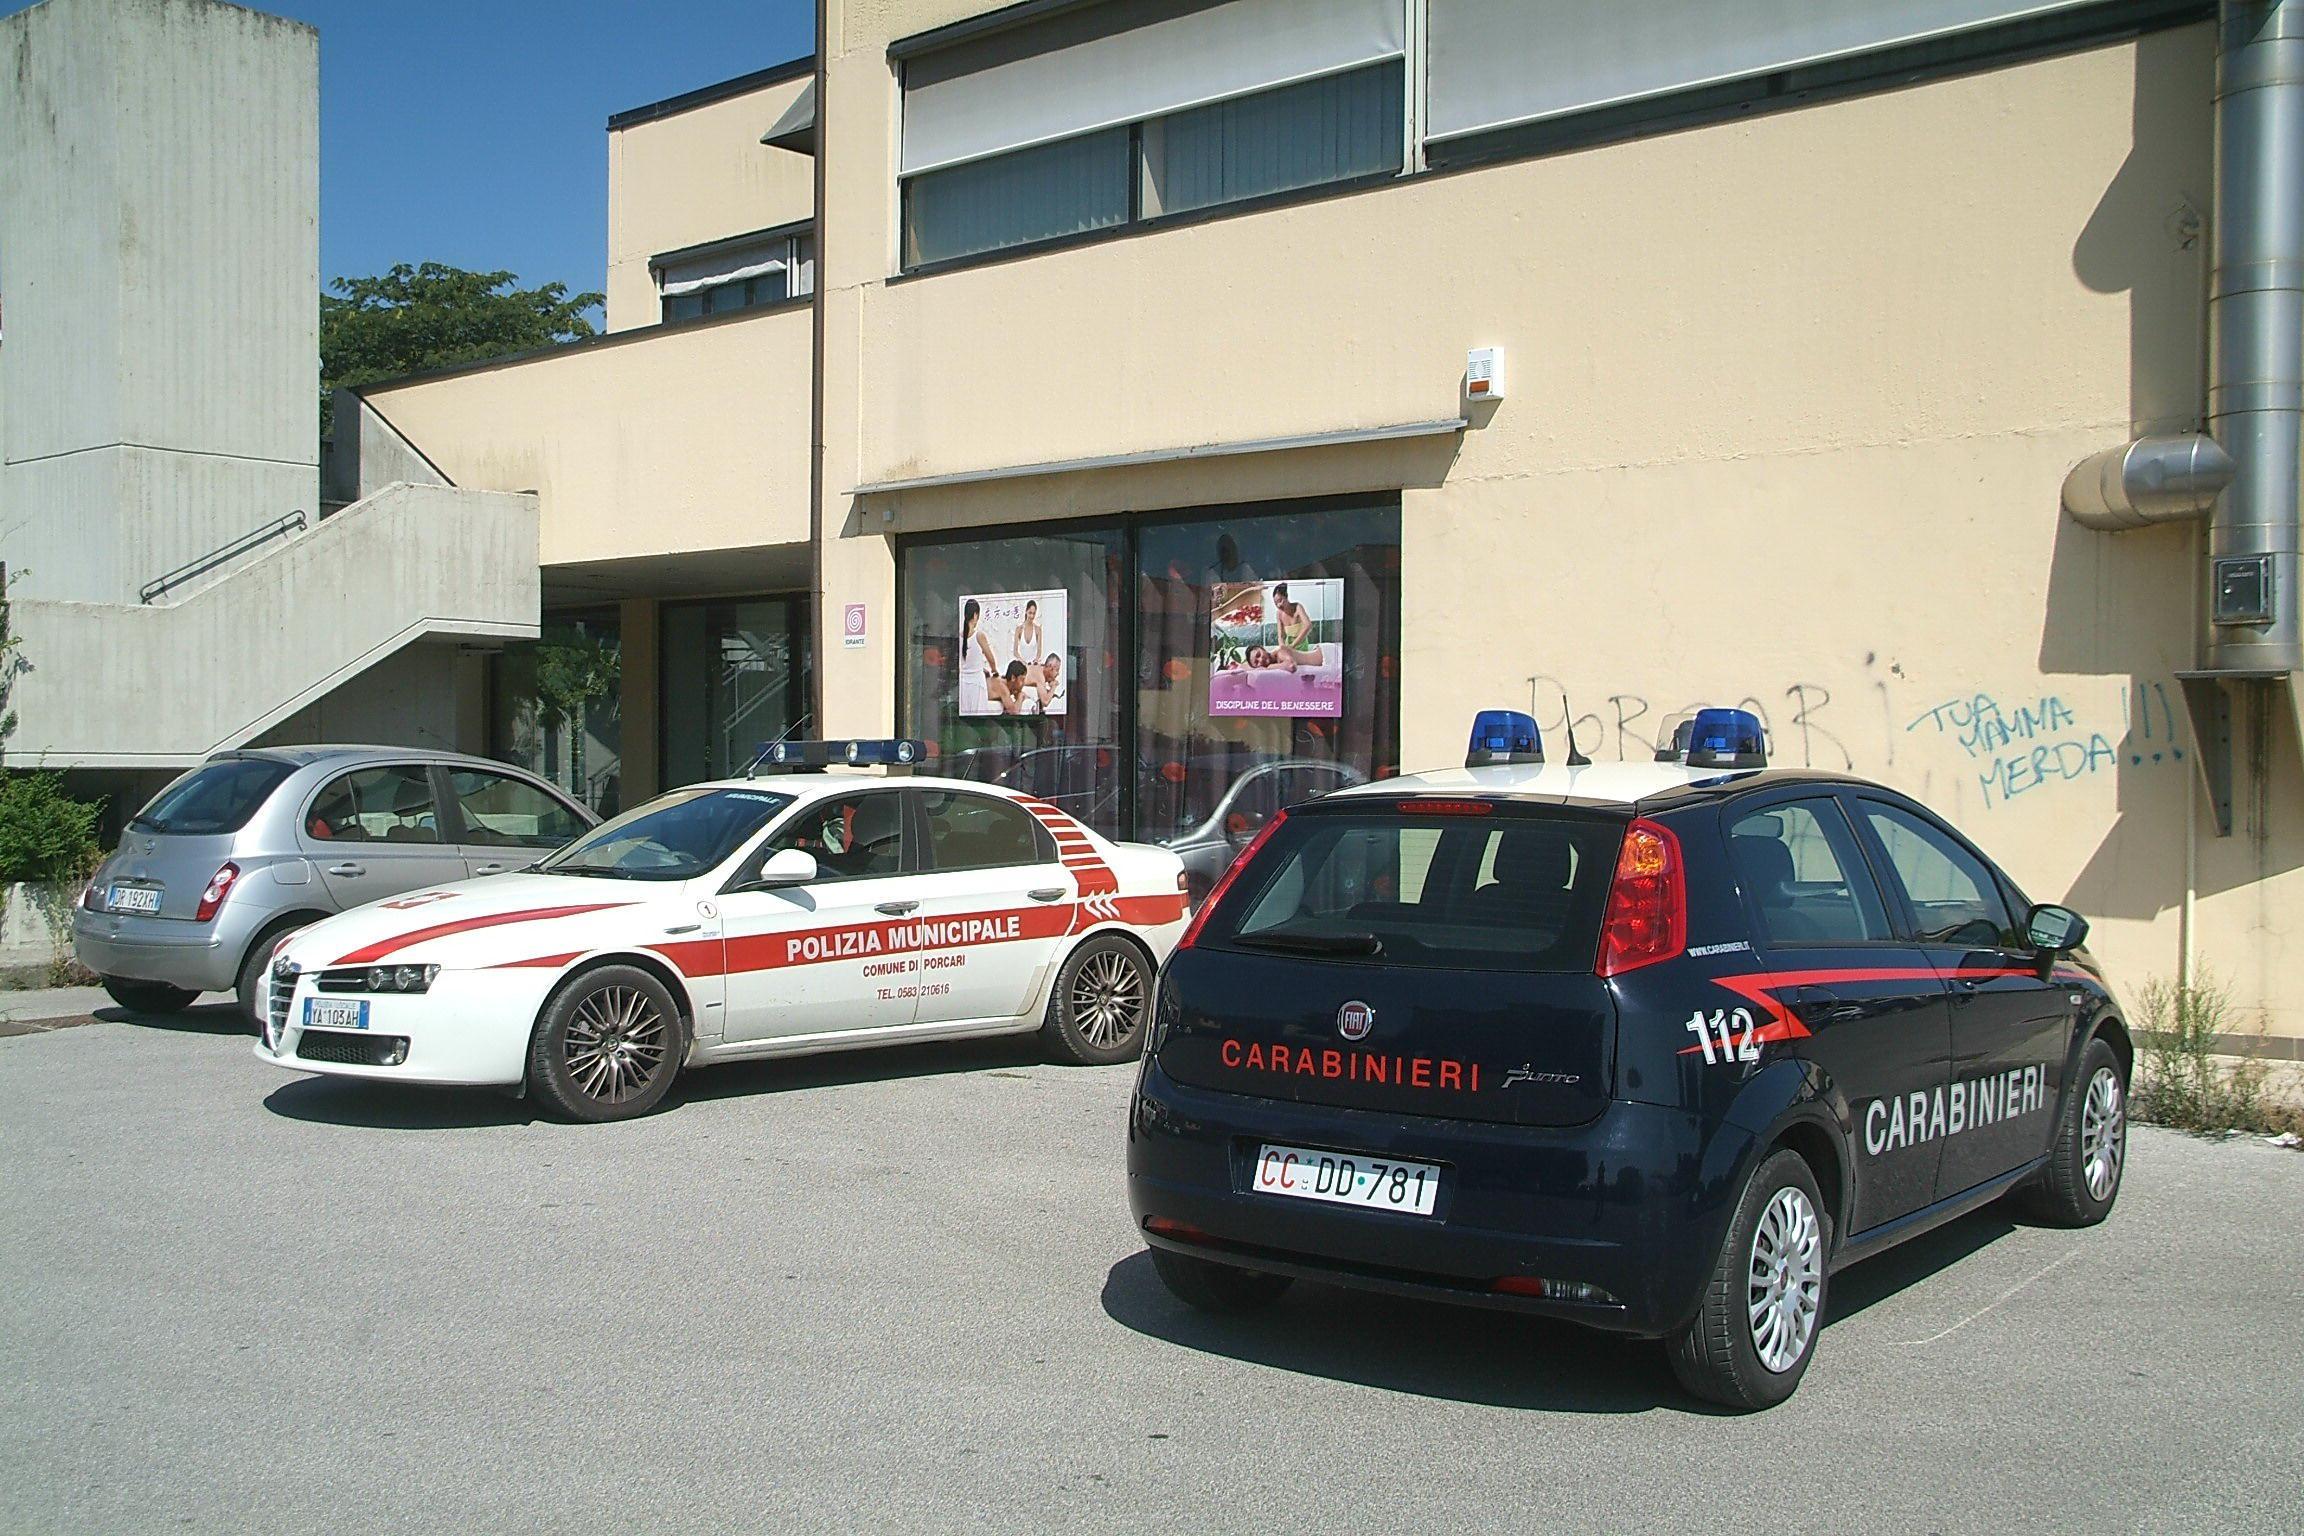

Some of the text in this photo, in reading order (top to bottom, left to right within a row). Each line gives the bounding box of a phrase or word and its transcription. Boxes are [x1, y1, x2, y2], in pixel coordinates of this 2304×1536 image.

[1216, 700, 1335, 712] DISCIPLINE DEL BENESSERE
[1906, 693, 2001, 732] TUA
[1958, 697, 2074, 758] MAMMA
[787, 916, 1020, 962] POLIZIA MUNICIPALE
[863, 955, 966, 977] COMUNE DI PORCARI
[877, 983, 950, 1000] TEL. 0583 210616
[312, 1007, 359, 1026] YA 103AH
[1345, 1011, 1366, 1030] FIAT
[1686, 1007, 1760, 1065] 112
[1221, 1039, 1479, 1091] CARABINIERI
[1865, 1062, 2046, 1156] CARABINIERI
[1261, 1150, 1427, 1208] CC DD 781
